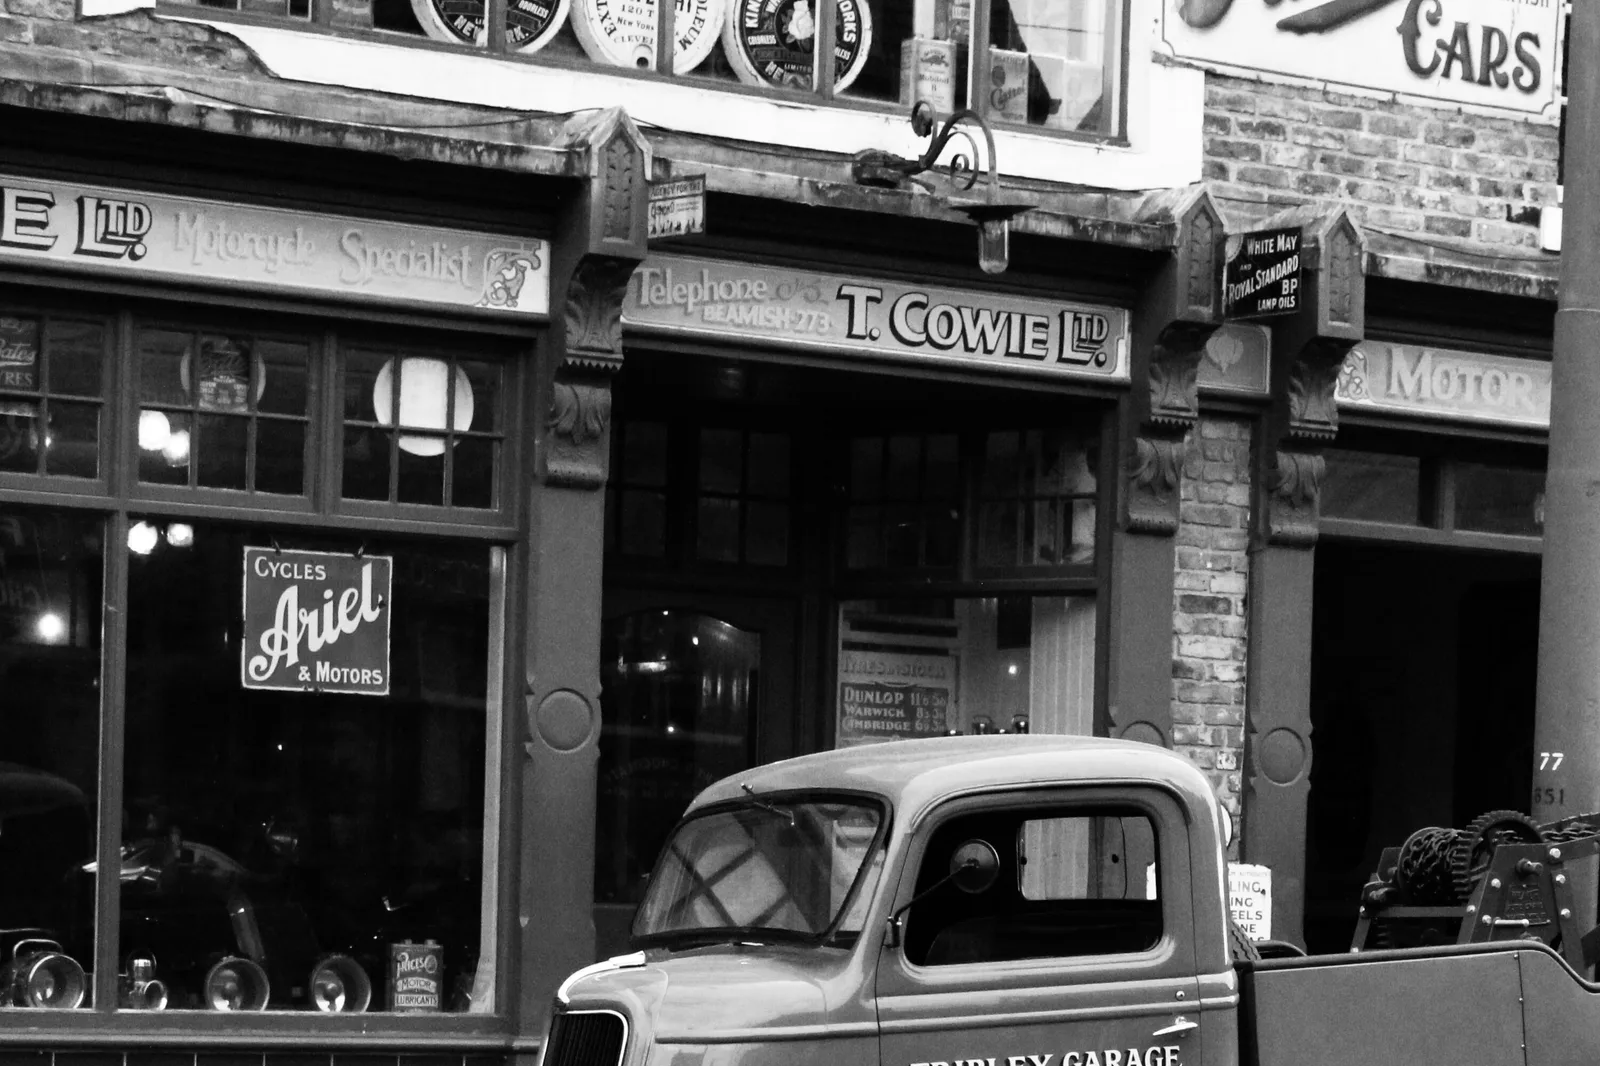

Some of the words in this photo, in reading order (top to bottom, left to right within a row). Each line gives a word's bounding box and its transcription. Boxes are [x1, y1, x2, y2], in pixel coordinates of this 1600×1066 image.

[1396, 0, 1542, 95] CARS
[174, 210, 318, 274] Motorcycle
[339, 228, 476, 290] Specialist
[1246, 238, 1275, 256] WHITE
[1277, 233, 1298, 252] MAY
[633, 267, 769, 317] Telephone
[1227, 277, 1256, 305] ROYAL
[1256, 254, 1299, 290] STANDARD
[1281, 278, 1298, 295] BP
[1257, 298, 1277, 311] LAMP
[1278, 295, 1296, 310] OILS
[888, 291, 1050, 361] COWIE
[1386, 346, 1535, 409] MOTOR
[254, 556, 327, 581] CYCLES
[249, 562, 383, 682] Ariel
[298, 665, 311, 682] &
[316, 660, 384, 685] MOTORS
[843, 686, 905, 705] DUNLOP
[842, 703, 906, 718] WARWICK
[1540, 752, 1564, 771] 77
